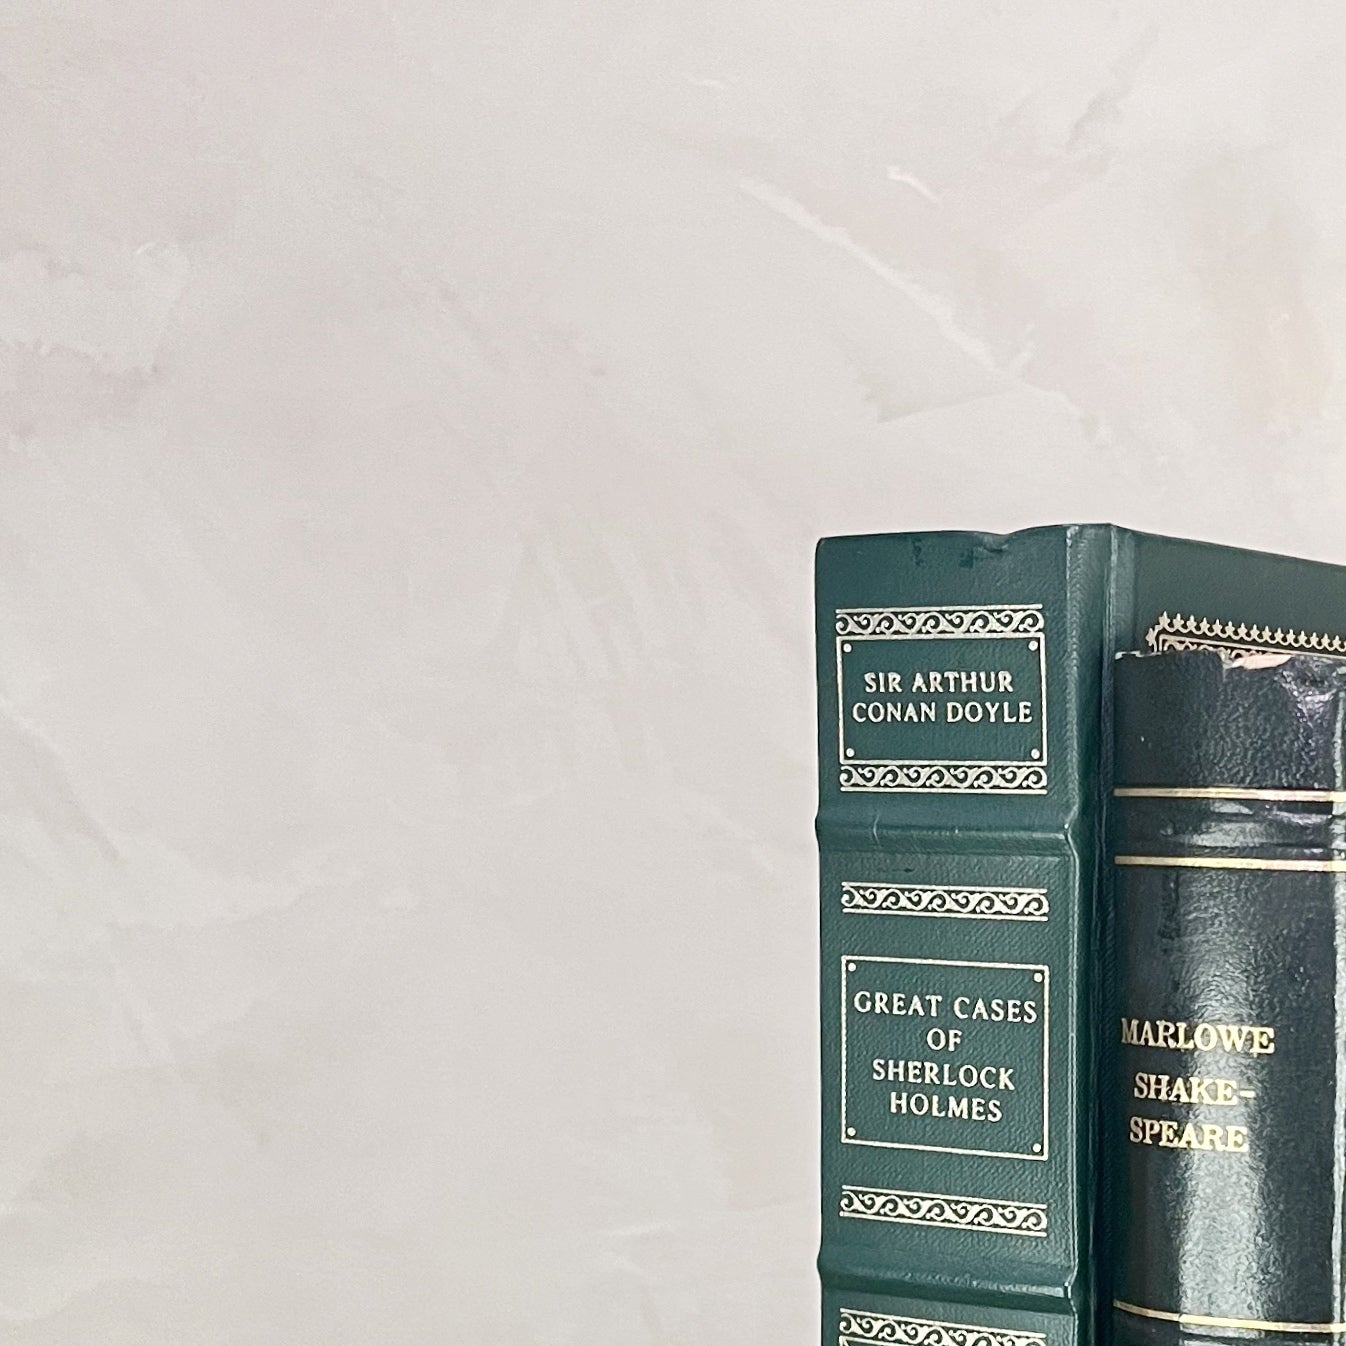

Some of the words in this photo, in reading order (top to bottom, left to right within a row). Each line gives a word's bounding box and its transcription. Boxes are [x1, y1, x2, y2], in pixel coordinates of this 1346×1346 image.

[864, 672, 902, 692] SIR
[912, 671, 1014, 692] ARTHUR
[852, 702, 936, 723] CONAN
[947, 702, 1033, 723] DOYLE
[854, 991, 942, 1017] GREAT
[953, 997, 1037, 1023] CASES
[926, 1028, 962, 1051] OF
[1121, 1018, 1275, 1053] MARLOWE
[872, 1058, 1015, 1090] SHERLOCK
[1134, 1072, 1256, 1105] SHAKE-
[890, 1092, 1002, 1122] HOLMES
[1130, 1117, 1249, 1152] SPEARE
